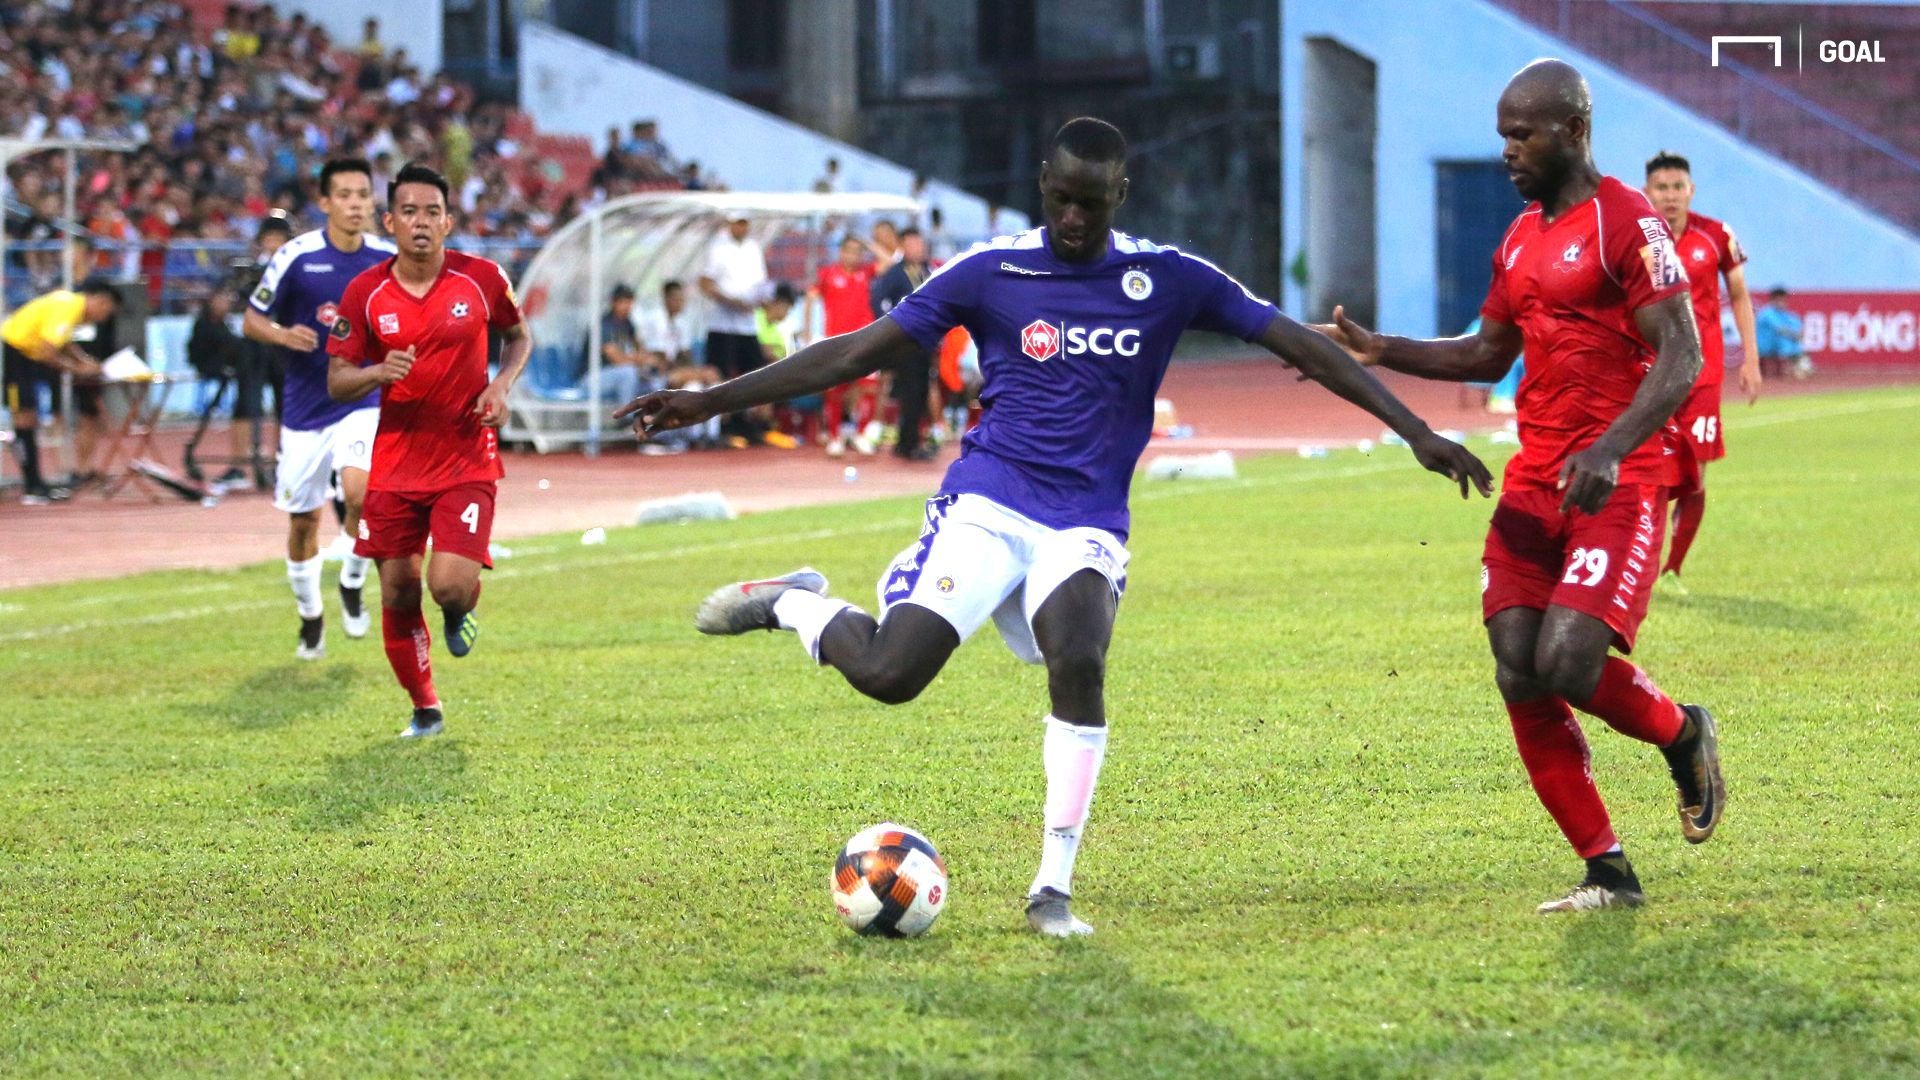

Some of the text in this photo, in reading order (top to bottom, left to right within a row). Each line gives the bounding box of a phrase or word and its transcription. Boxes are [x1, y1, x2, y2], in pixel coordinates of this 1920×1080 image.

[1067, 327, 1140, 357] SCG
[1830, 302, 1916, 352] BÓNG
[1691, 416, 1717, 443] 45
[460, 502, 480, 534] 4
[1562, 547, 1609, 587] 29
